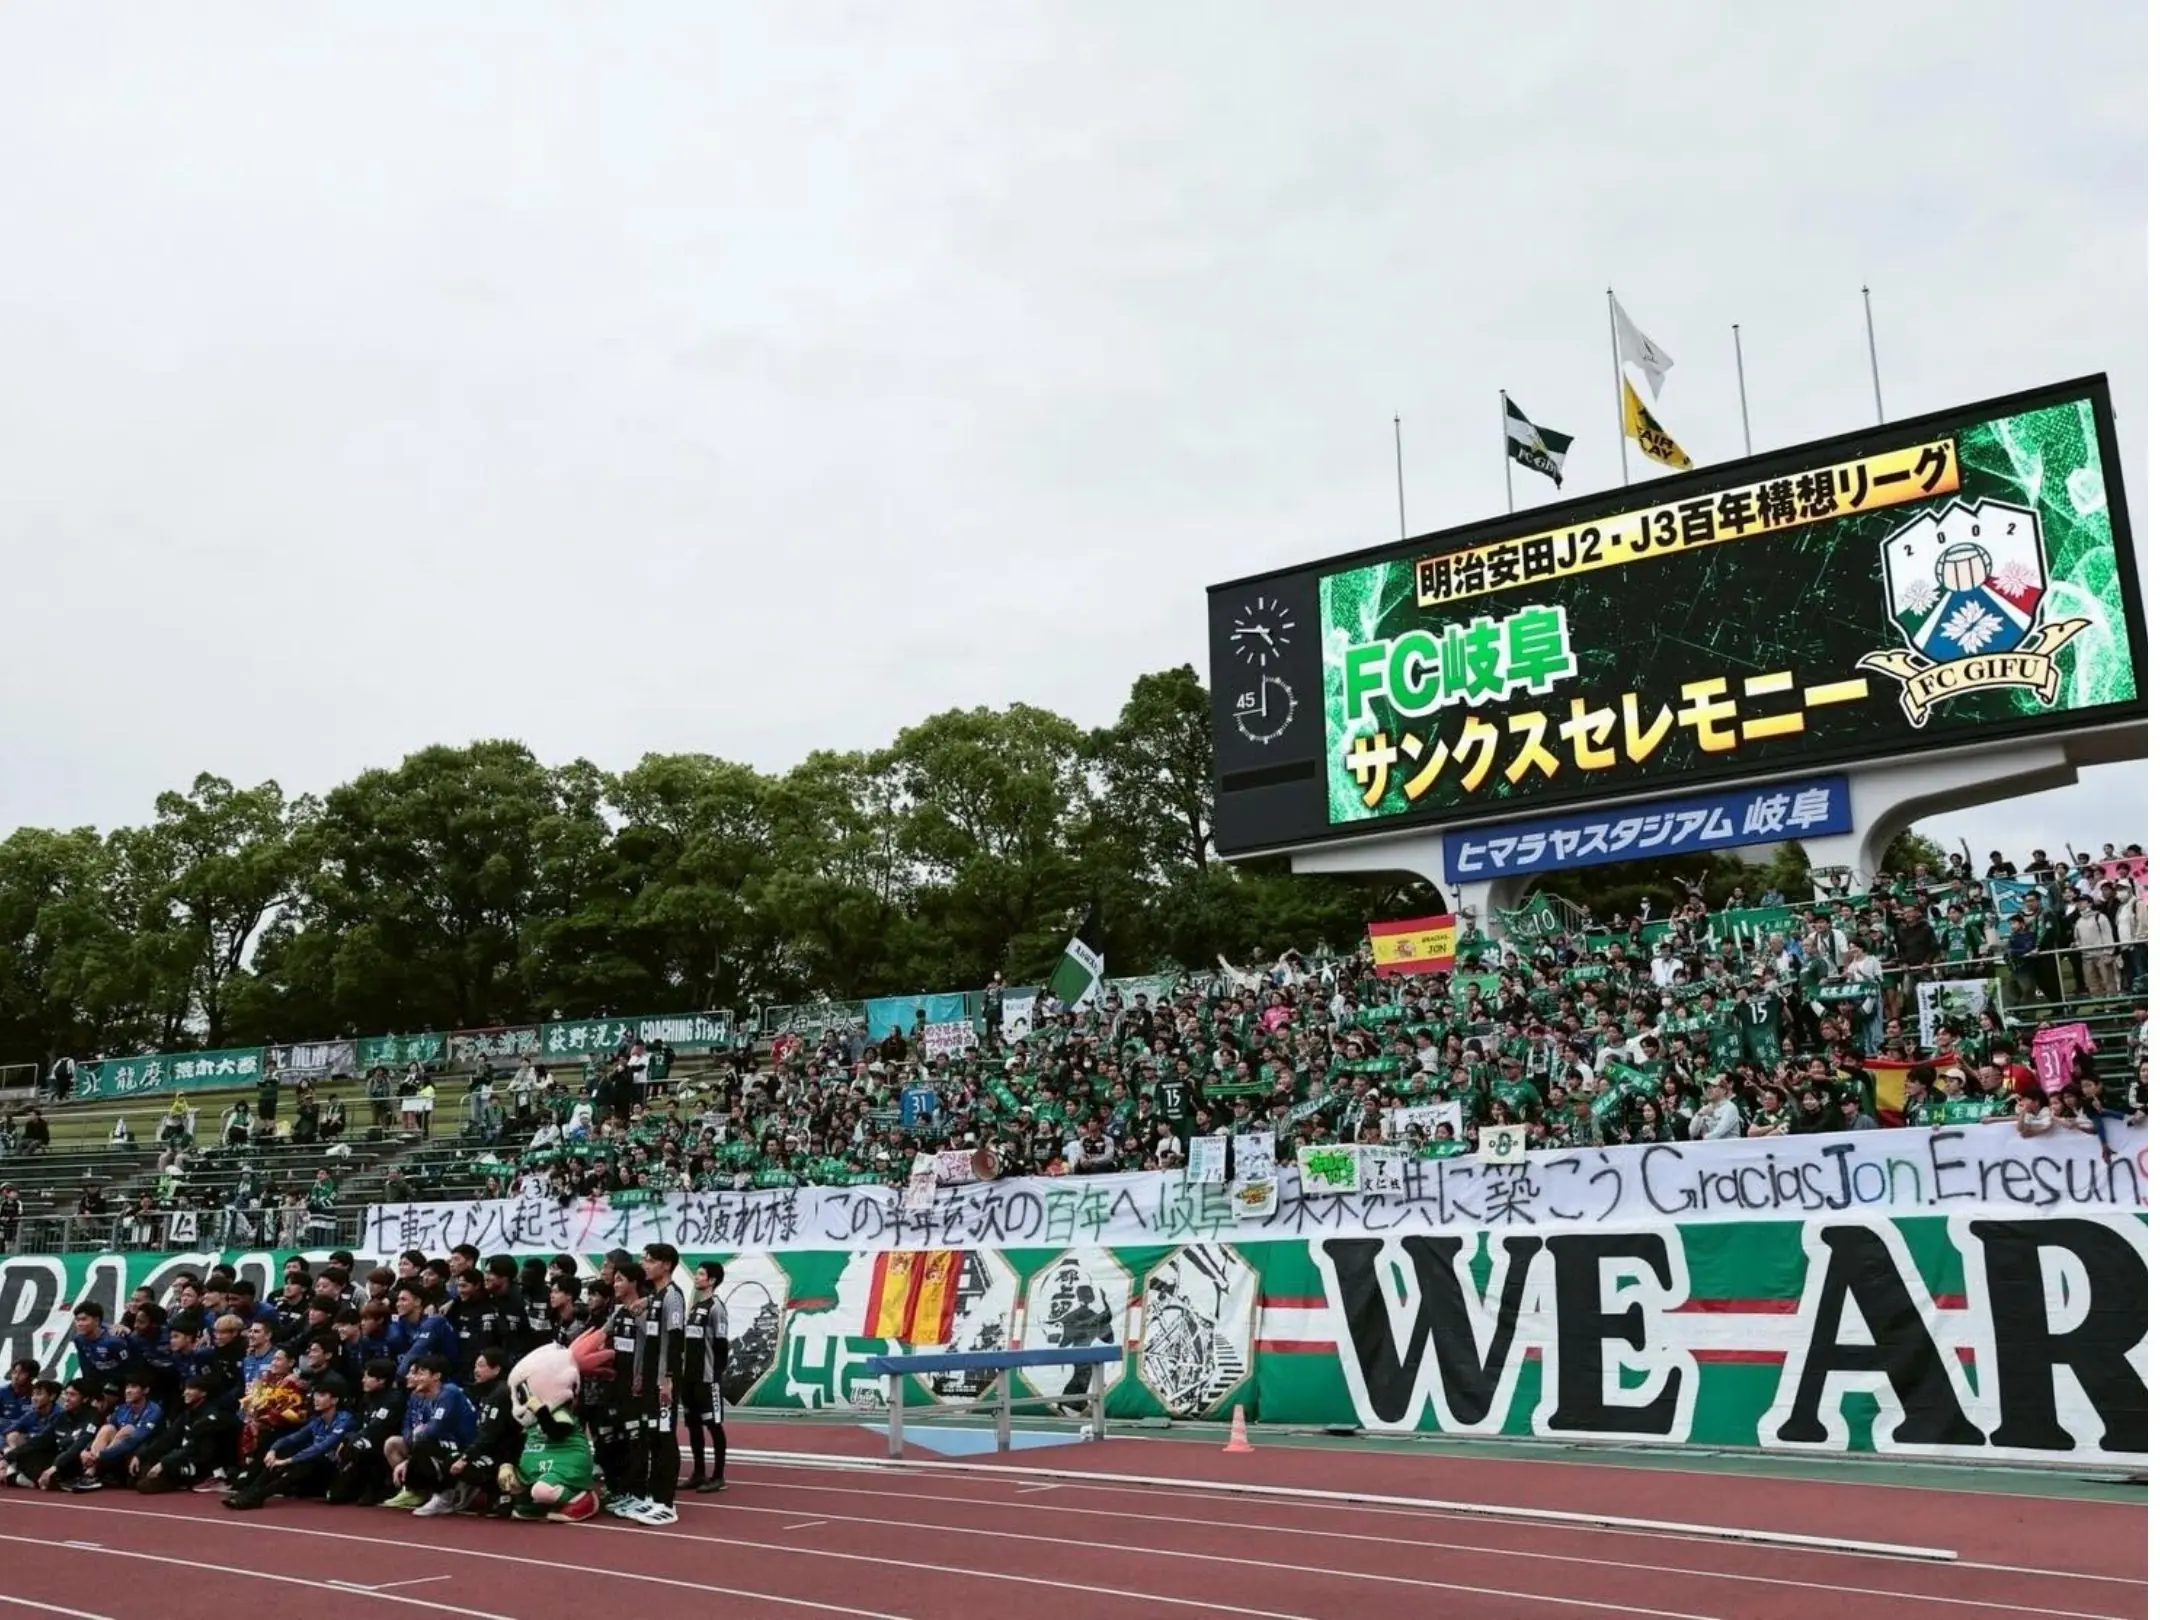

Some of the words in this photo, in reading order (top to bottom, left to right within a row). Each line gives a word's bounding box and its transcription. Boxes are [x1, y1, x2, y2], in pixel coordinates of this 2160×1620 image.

[1420, 441, 1952, 600] 明治安田J2・J3百年構想リーグ
[1343, 606, 1573, 722] FC岐阜
[1917, 667, 1958, 697] FC
[1963, 657, 2041, 682] GIFU
[1236, 692, 1256, 709] 45
[1346, 670, 1869, 808] サンクスセレモニー
[1457, 806, 1734, 872] ヒマラヤスタジアム
[1742, 787, 1831, 835] 岐阜
[1531, 907, 1556, 935] 10
[1427, 942, 1447, 955] JON
[1749, 1001, 1768, 1025] 15
[640, 1018, 694, 1043] COACHING
[694, 1016, 726, 1042] STAFF
[2041, 1049, 2060, 1078] 31
[911, 1095, 927, 1114] 31
[1165, 1088, 1181, 1108] 15
[1323, 1233, 1684, 1435] WE
